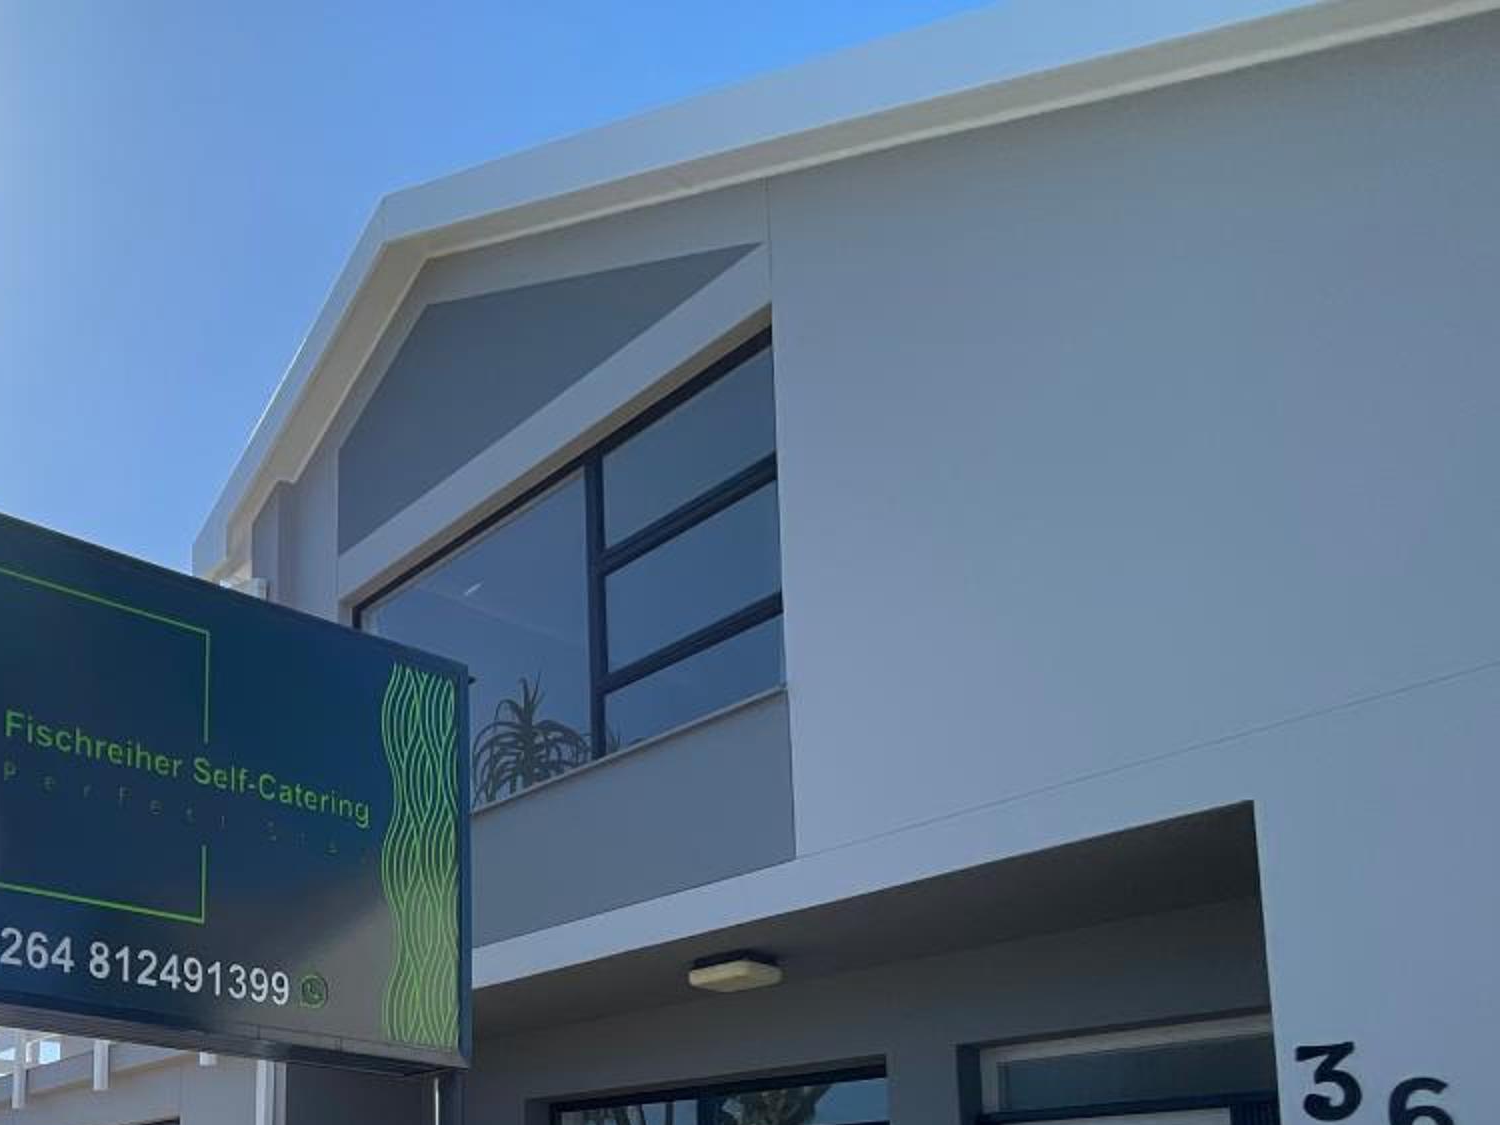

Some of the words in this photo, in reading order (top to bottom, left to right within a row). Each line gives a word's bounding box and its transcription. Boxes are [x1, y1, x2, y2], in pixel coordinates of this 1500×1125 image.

[5, 709, 183, 777] Fischreiher
[194, 757, 370, 828] Self-Catering
[88, 941, 291, 1005] 812491399
